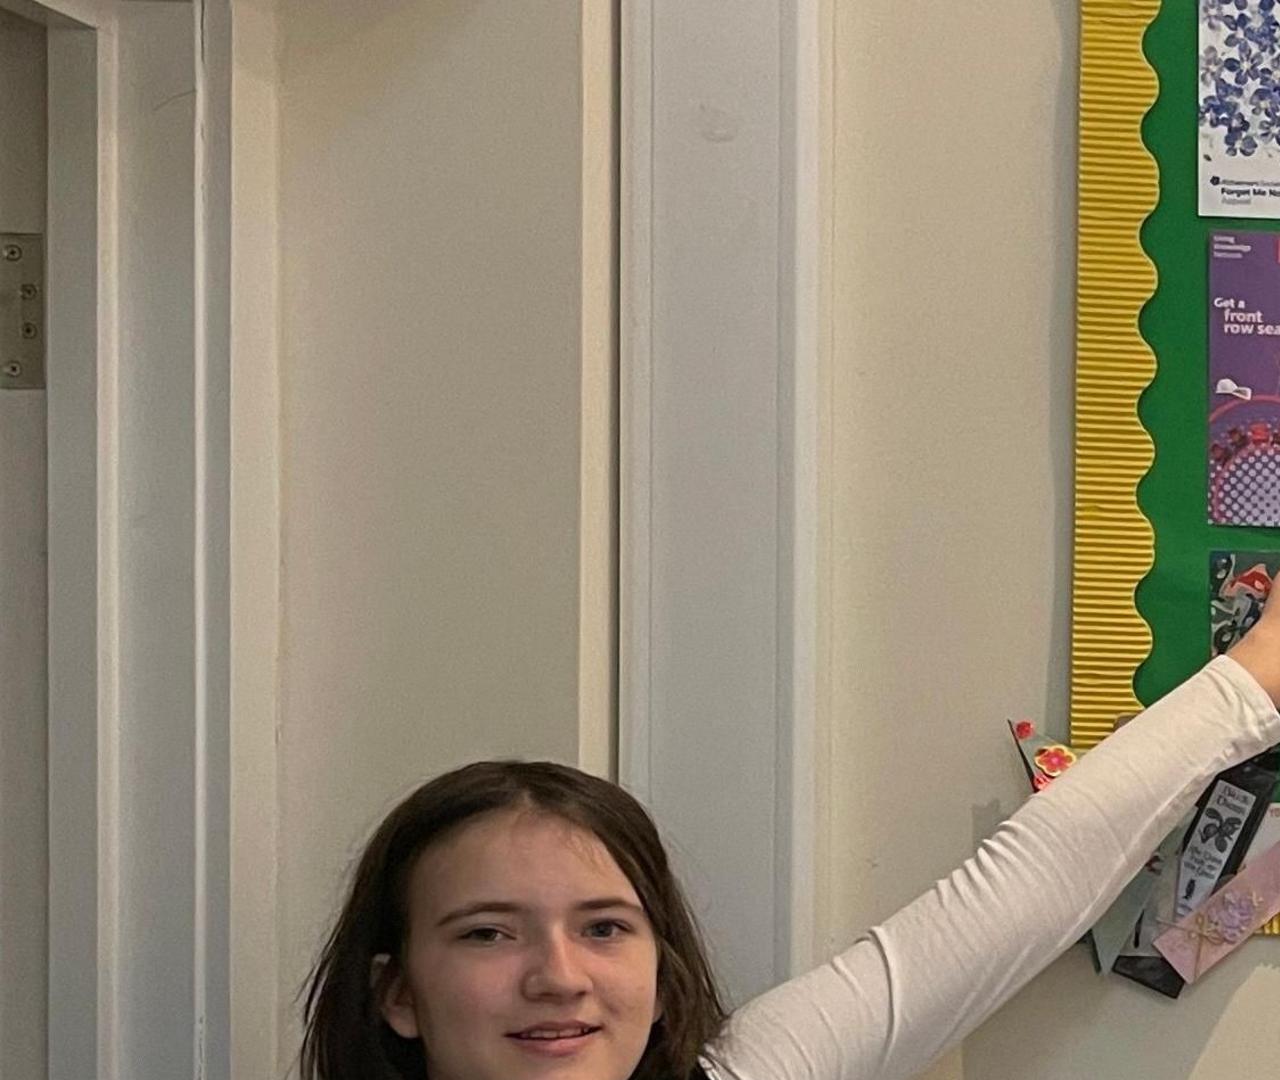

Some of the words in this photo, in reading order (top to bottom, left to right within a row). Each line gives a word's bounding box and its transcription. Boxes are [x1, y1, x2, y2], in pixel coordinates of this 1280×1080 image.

[1221, 187, 1250, 198] Forget
[1253, 188, 1266, 196] Me
[1214, 297, 1235, 308] Get
[1237, 300, 1245, 308] a
[1224, 308, 1263, 323] front
[1223, 323, 1254, 334] row
